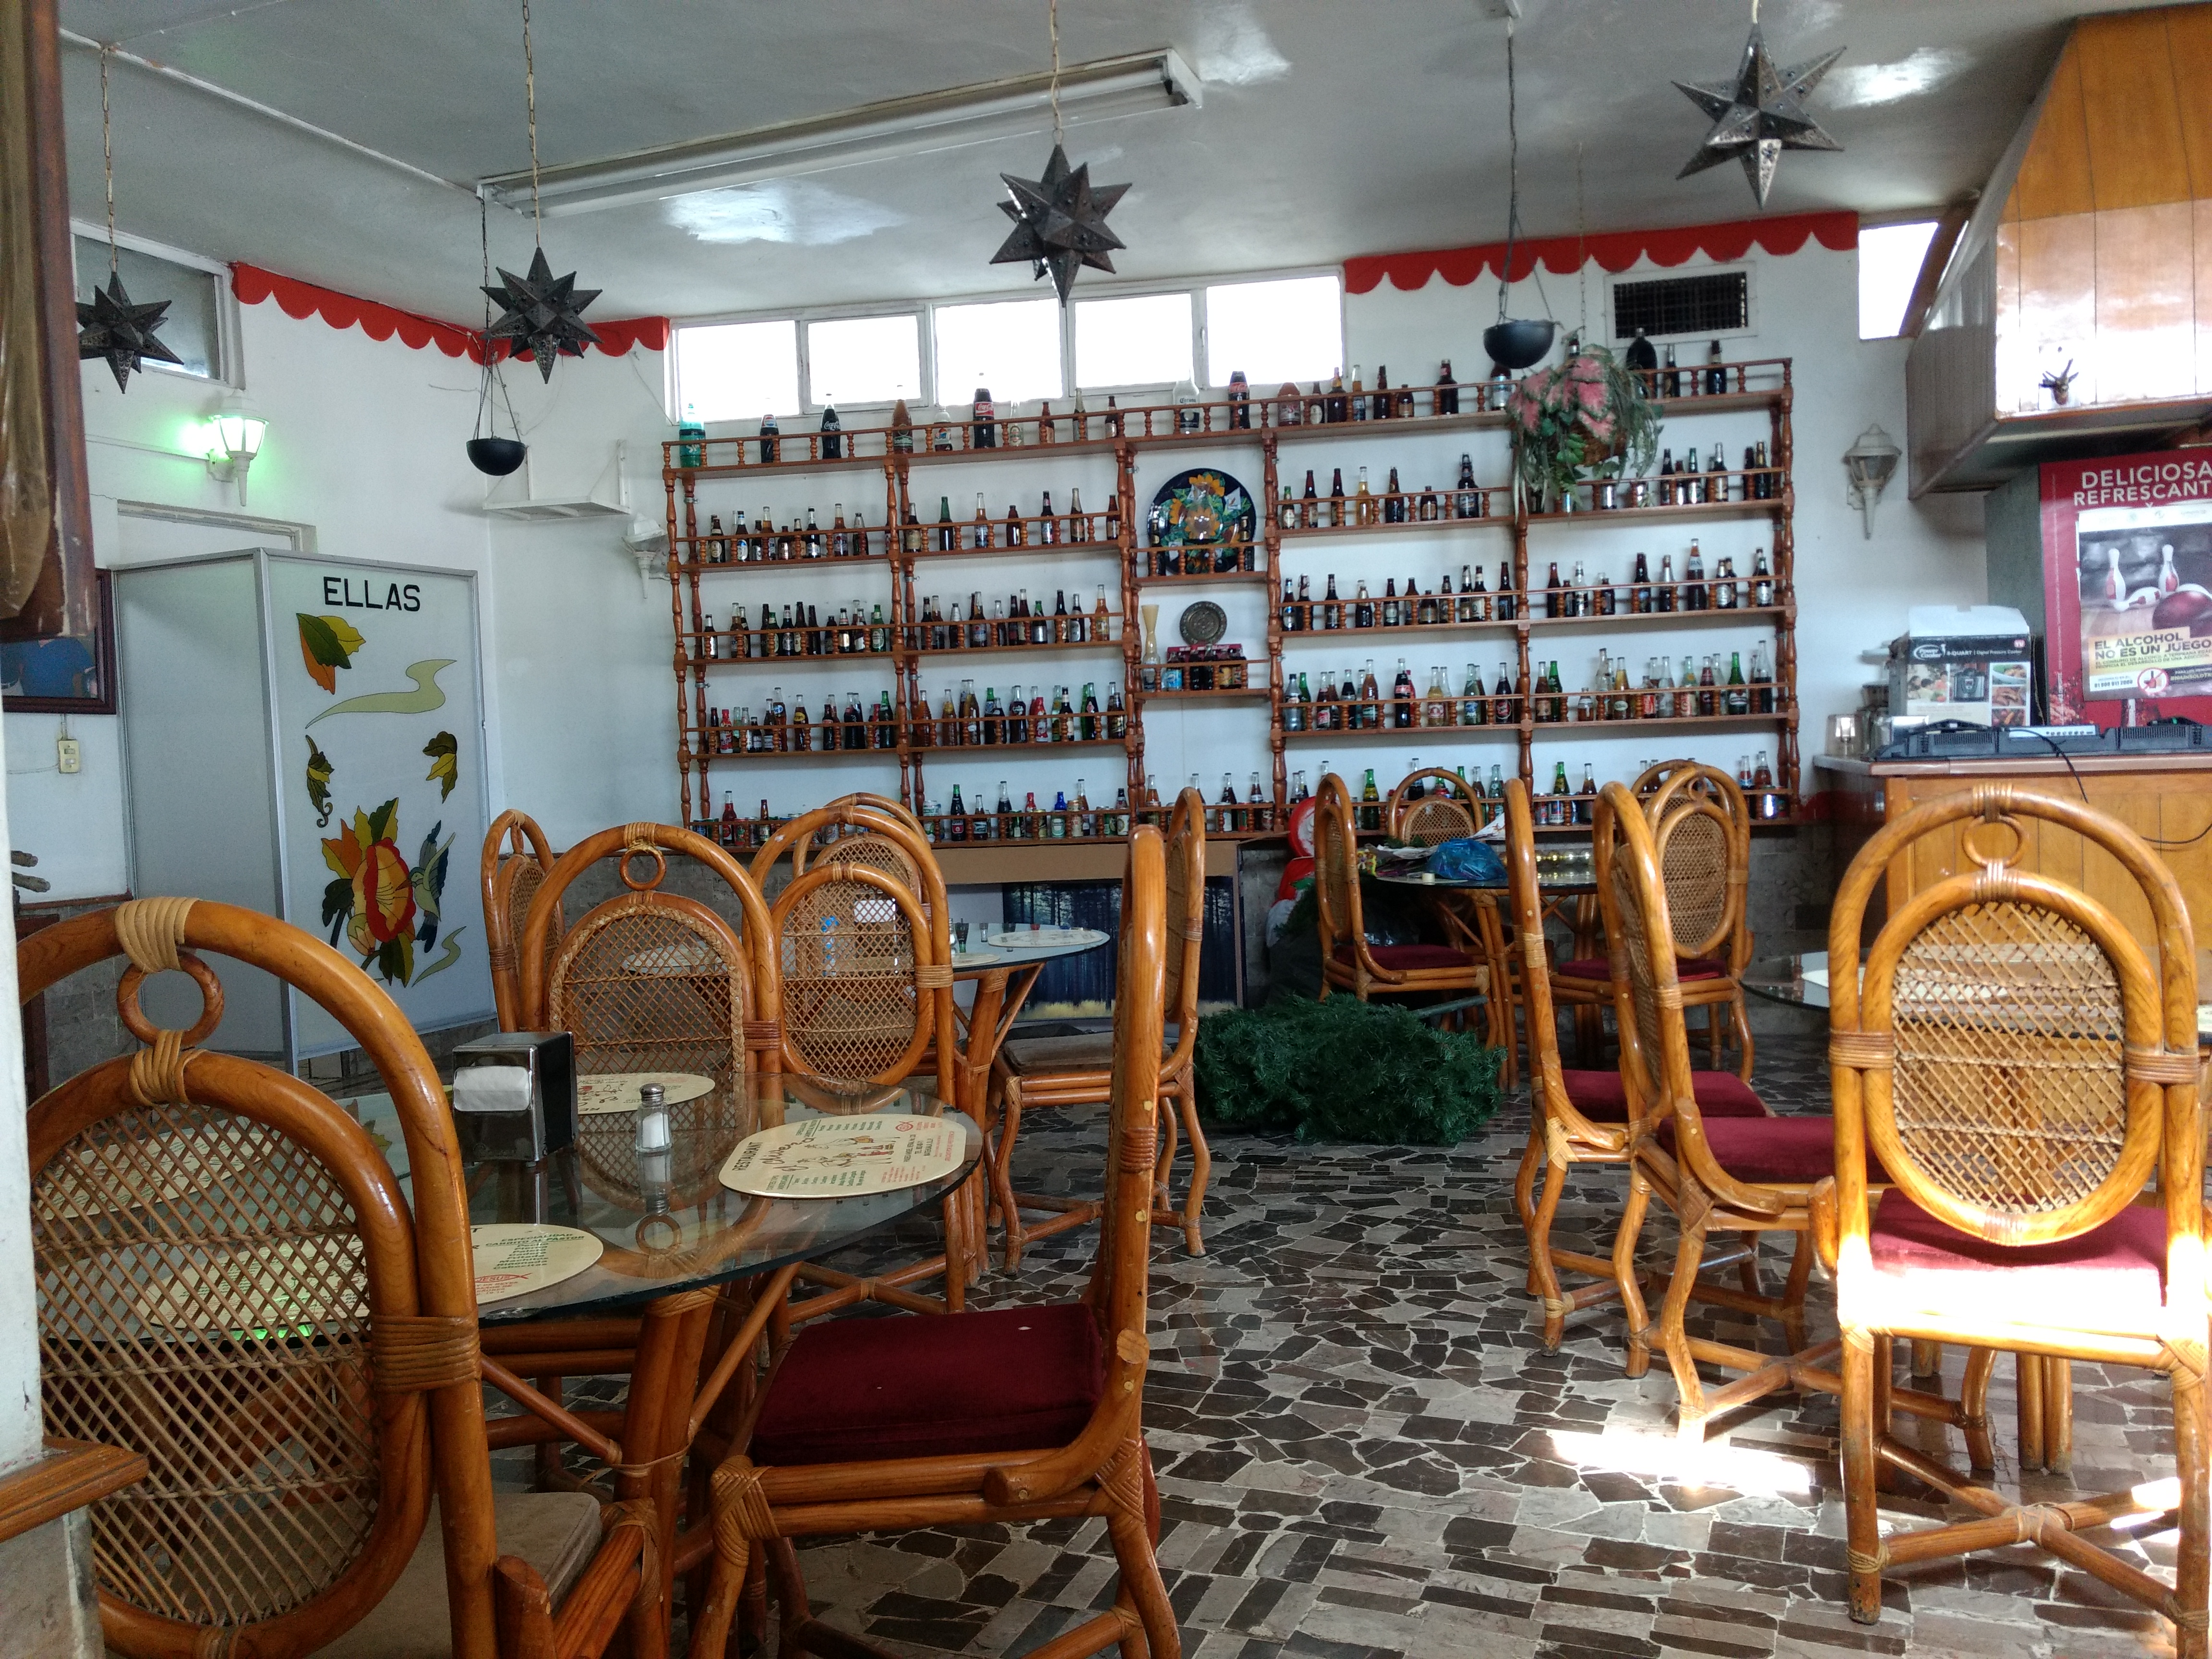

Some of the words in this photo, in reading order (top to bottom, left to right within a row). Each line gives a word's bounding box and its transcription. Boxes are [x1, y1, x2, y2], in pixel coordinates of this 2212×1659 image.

[2082, 461, 2212, 489] DELICIOSA
[324, 576, 421, 612] ELLAS
[2095, 640, 2111, 650] EL
[2116, 632, 2184, 647] ALCOHOL
[2095, 650, 2116, 660] NO
[2120, 647, 2137, 658] ES
[2140, 644, 2161, 655] UN
[2165, 639, 2212, 653] JUEGO
[732, 1142, 763, 1171] RESTAURANT
[501, 1233, 573, 1242] ESPECIALIDAD
